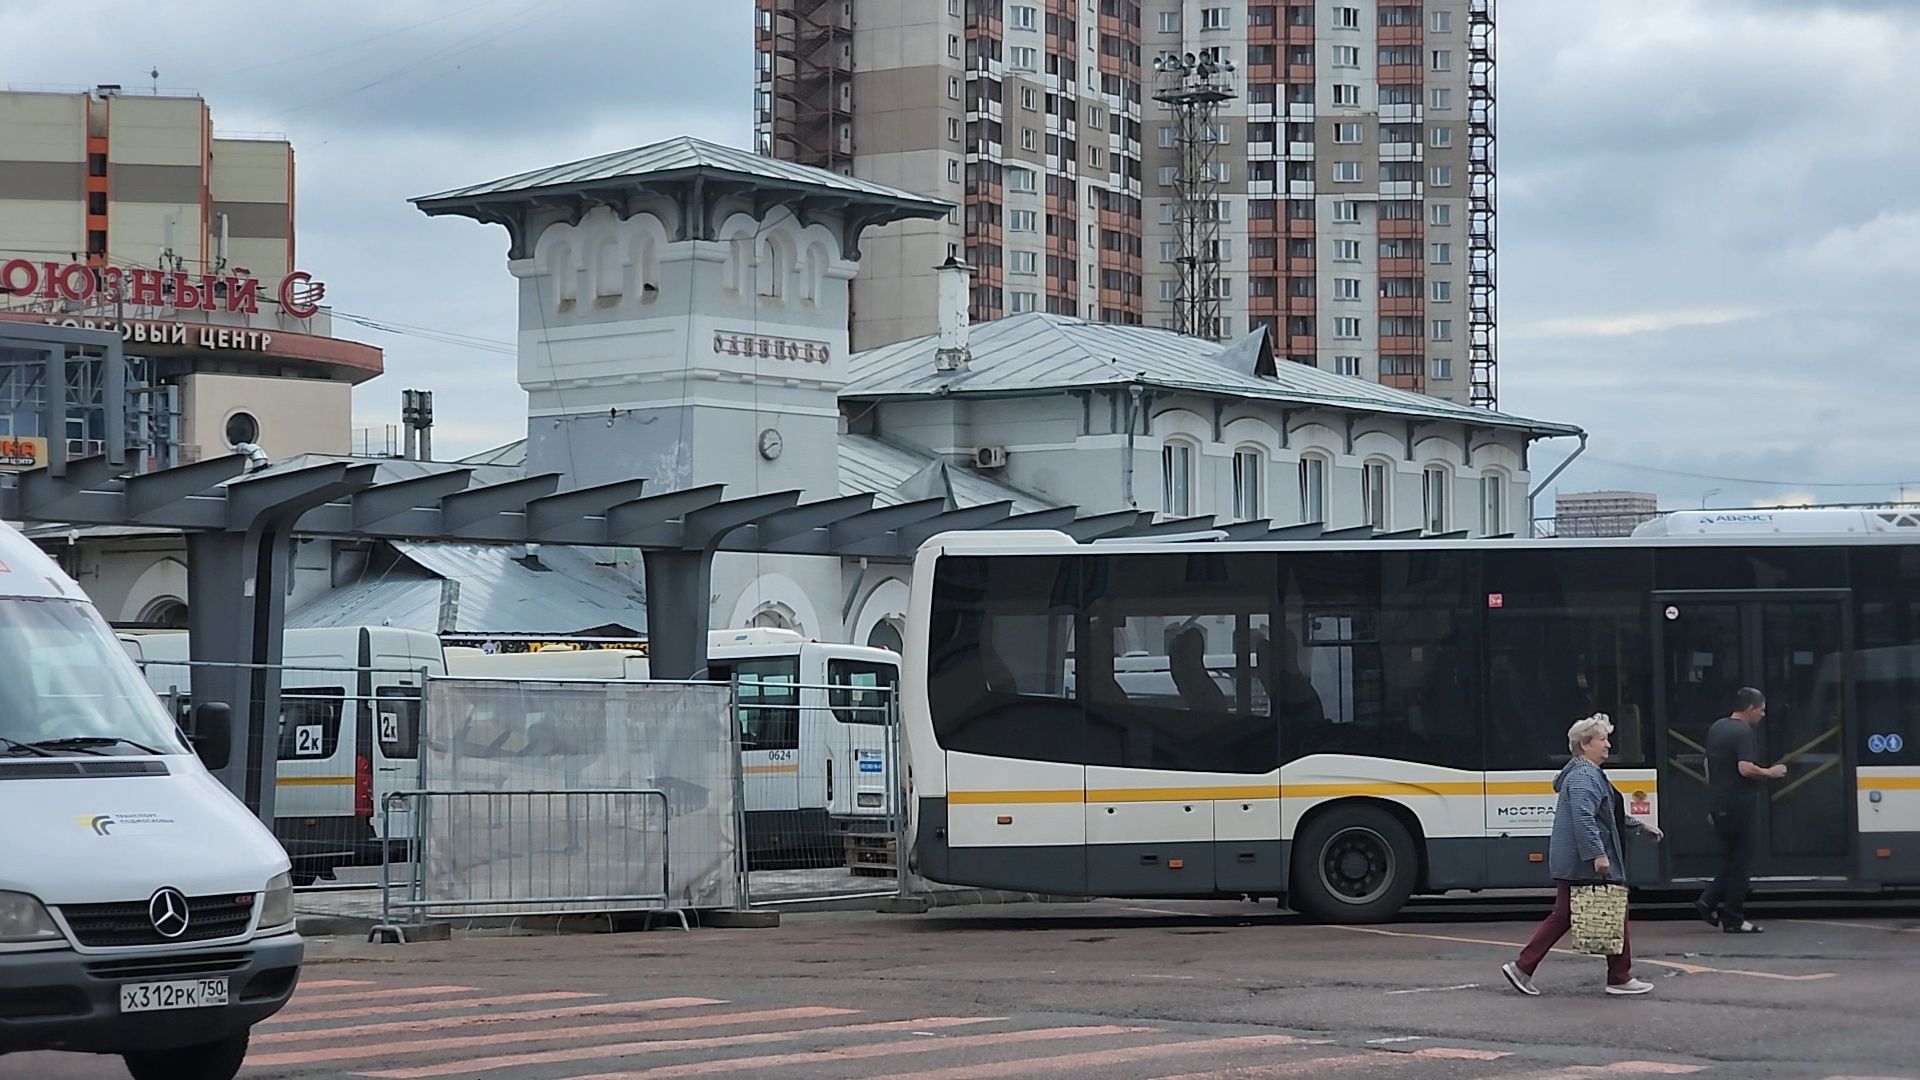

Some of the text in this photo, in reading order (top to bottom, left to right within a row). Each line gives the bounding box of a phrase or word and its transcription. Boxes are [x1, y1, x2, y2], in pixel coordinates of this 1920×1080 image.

[199, 328, 273, 352] ЦЕНТР
[714, 334, 830, 364] ОДИНЦОВО
[0, 440, 37, 458] КА
[768, 750, 791, 761] 0624
[127, 980, 224, 1009] Х312РК 750
